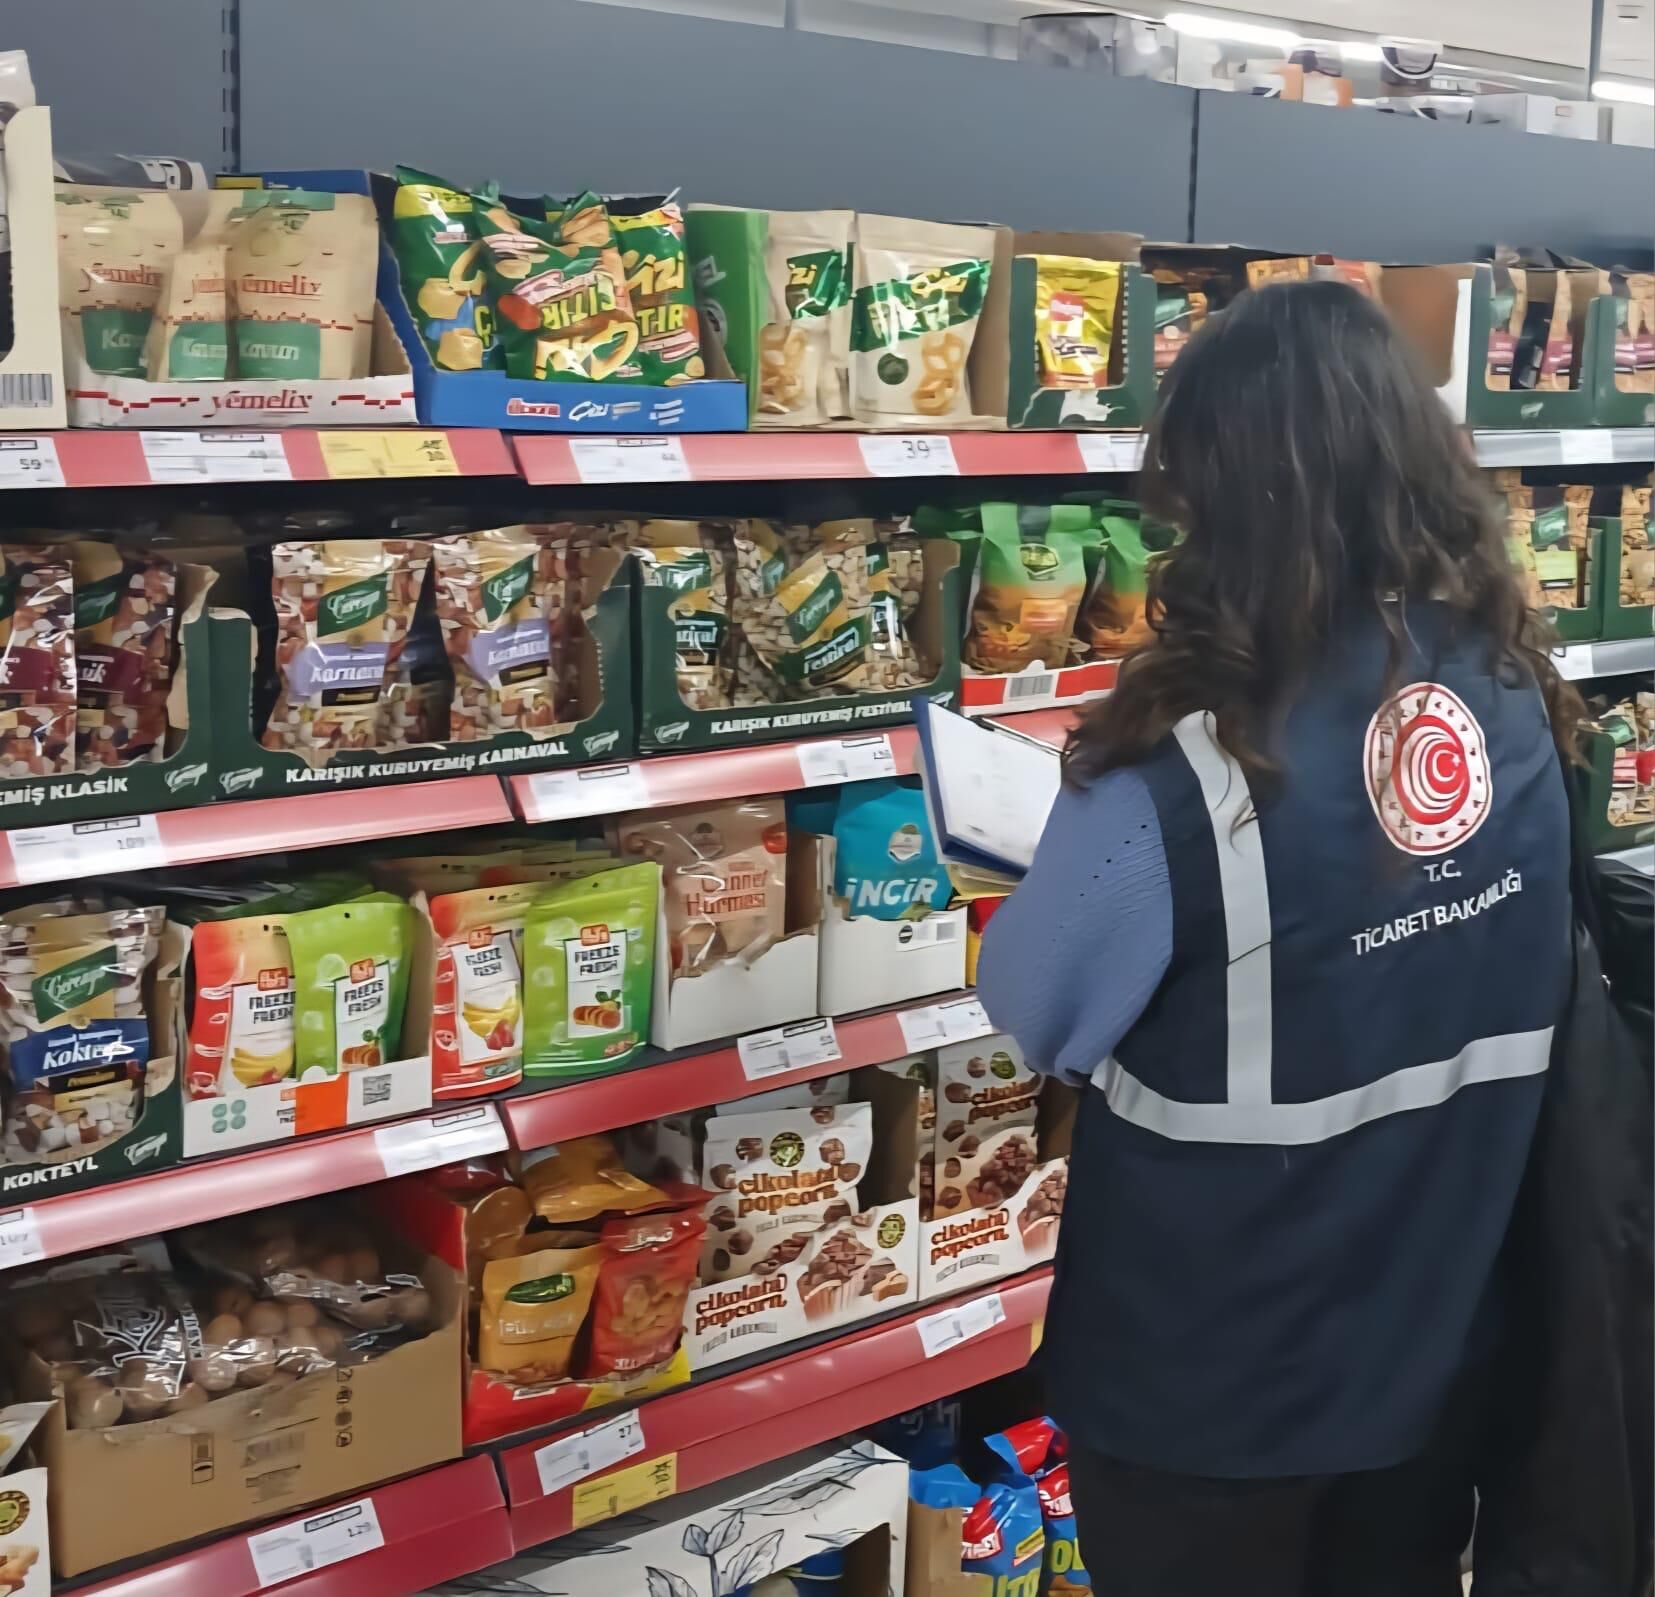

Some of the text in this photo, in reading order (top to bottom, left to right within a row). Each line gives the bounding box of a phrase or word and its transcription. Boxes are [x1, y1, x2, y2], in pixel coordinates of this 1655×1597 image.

[285, 766, 365, 784] KARIŞIK
[478, 741, 570, 766] KARNAVAL
[50, 776, 129, 800] KLASİK
[1351, 868, 1523, 956] TİCARET BAKANLIĞI
[3, 1156, 99, 1191] KOKTEYL
